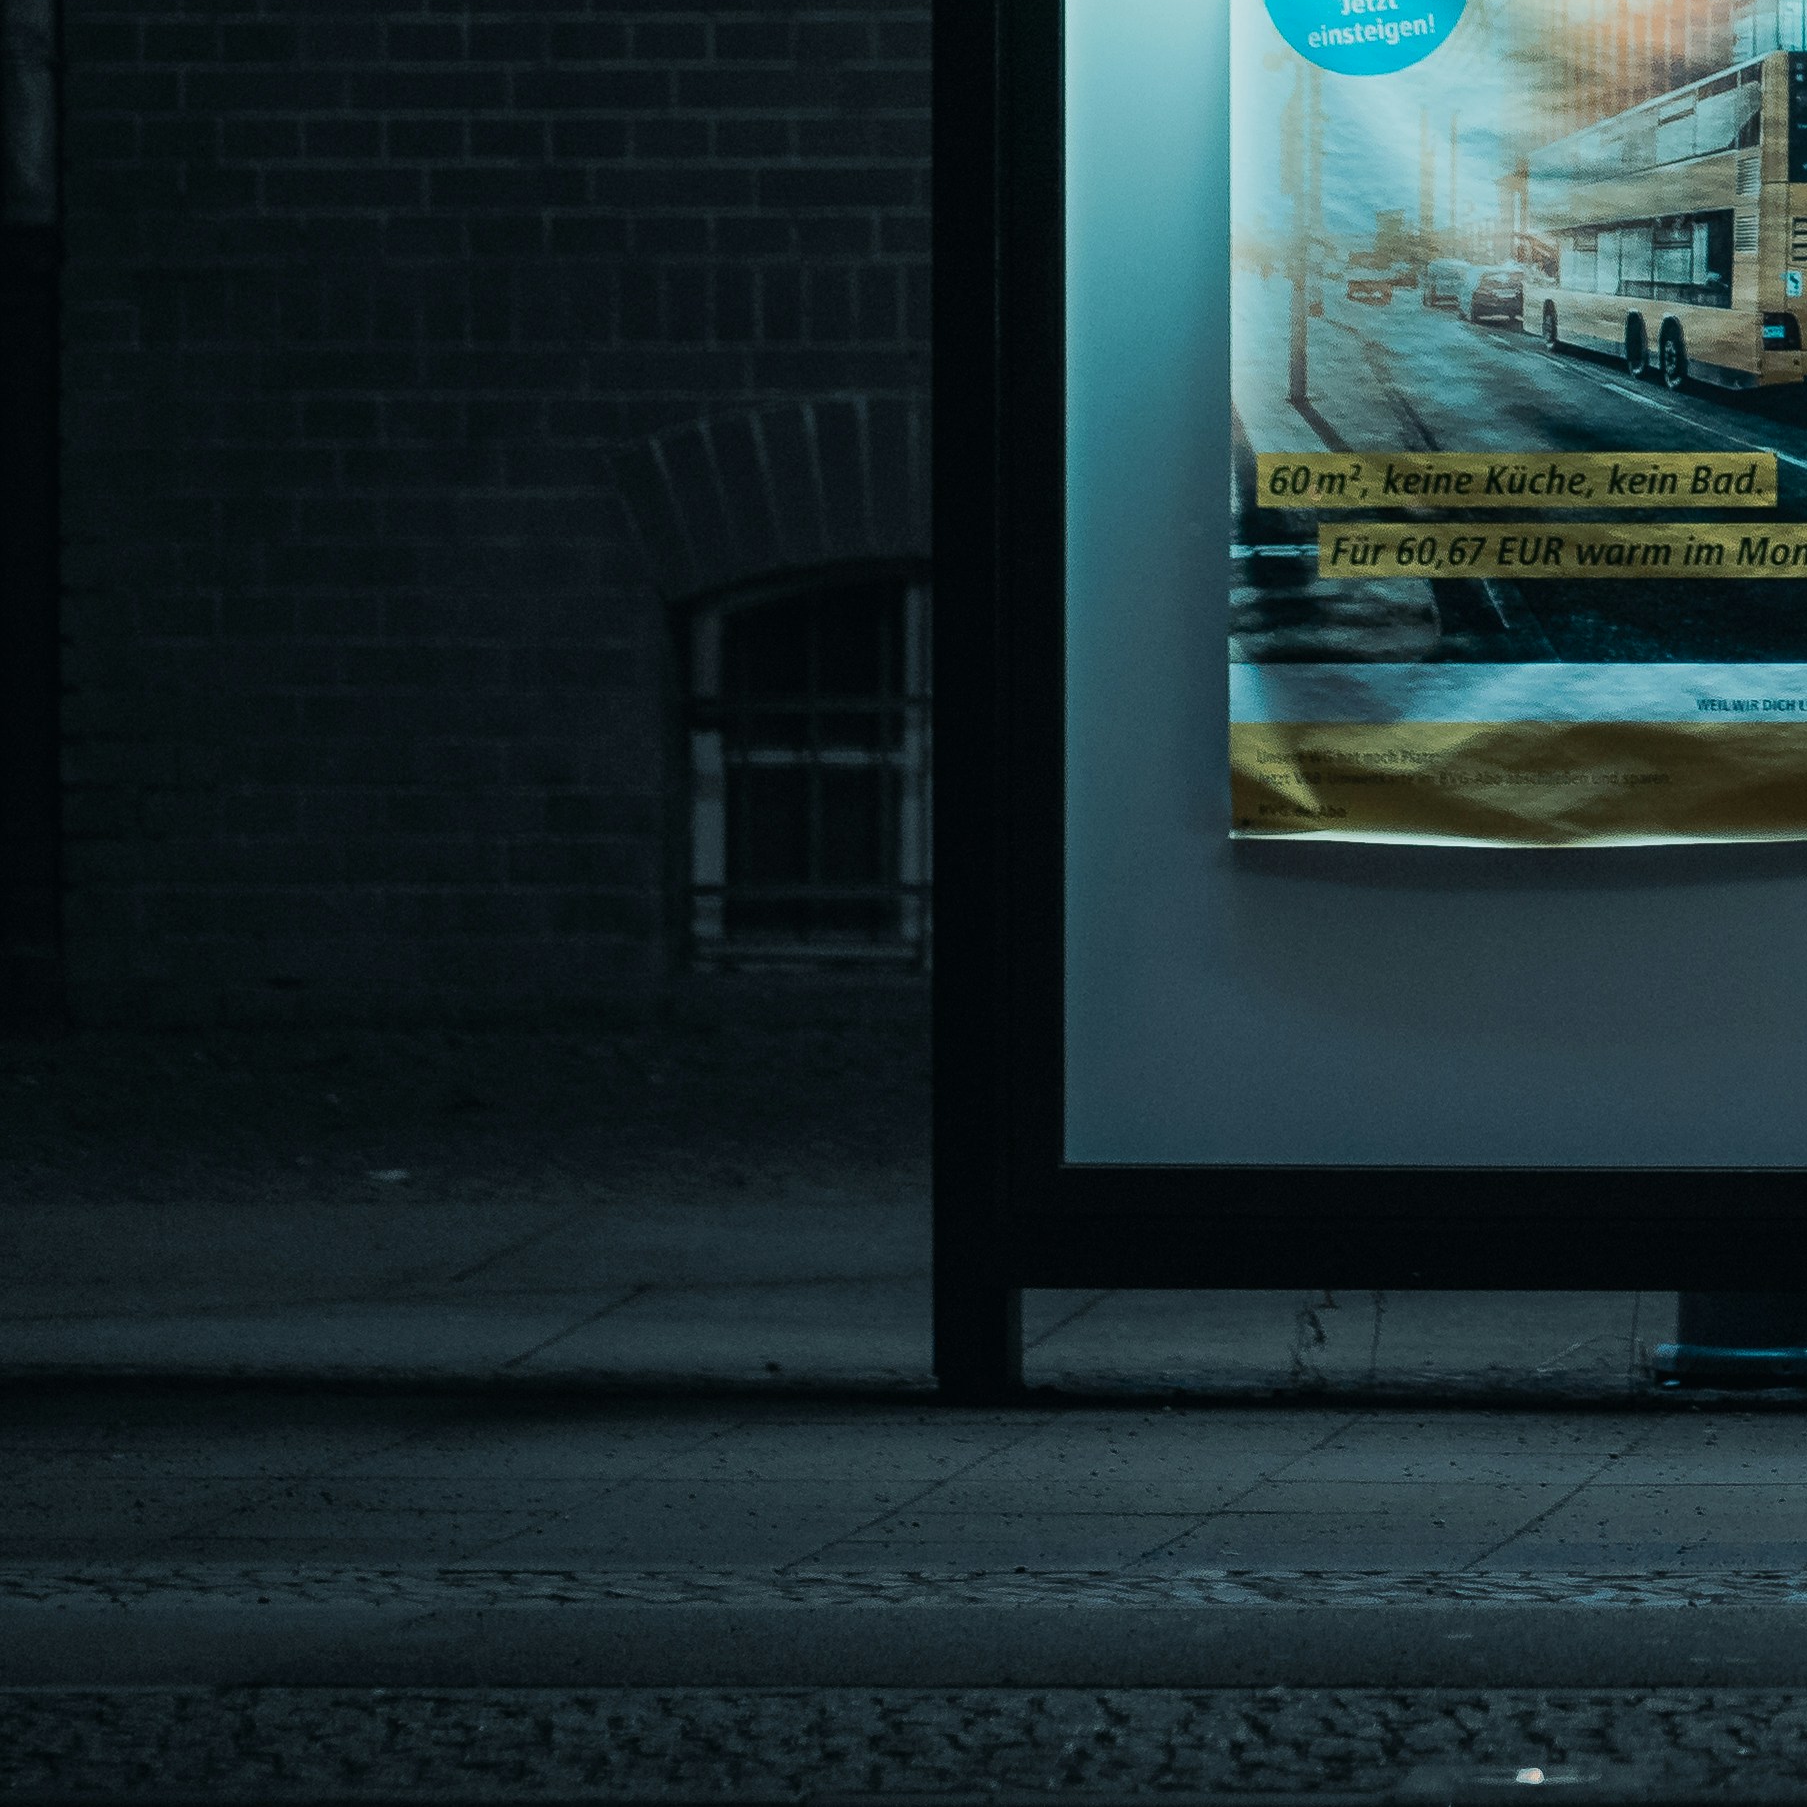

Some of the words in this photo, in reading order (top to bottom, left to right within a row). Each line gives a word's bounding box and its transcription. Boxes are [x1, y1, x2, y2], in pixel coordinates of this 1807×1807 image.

[1307, 13, 1436, 49] einsteigen!
[1381, 463, 1474, 496] keine
[1485, 463, 1595, 500] Küche,
[1607, 462, 1678, 495] kein
[1690, 462, 1765, 495] Bad.
[1329, 535, 1386, 567] Für
[1395, 535, 1488, 570] 60,67
[1496, 535, 1565, 567] EUR
[1575, 543, 1673, 567] warm
[1682, 535, 1725, 566] im
[1697, 698, 1730, 712] WEIL
[1732, 698, 1761, 712] WIR
[1762, 698, 1797, 712] DICH
